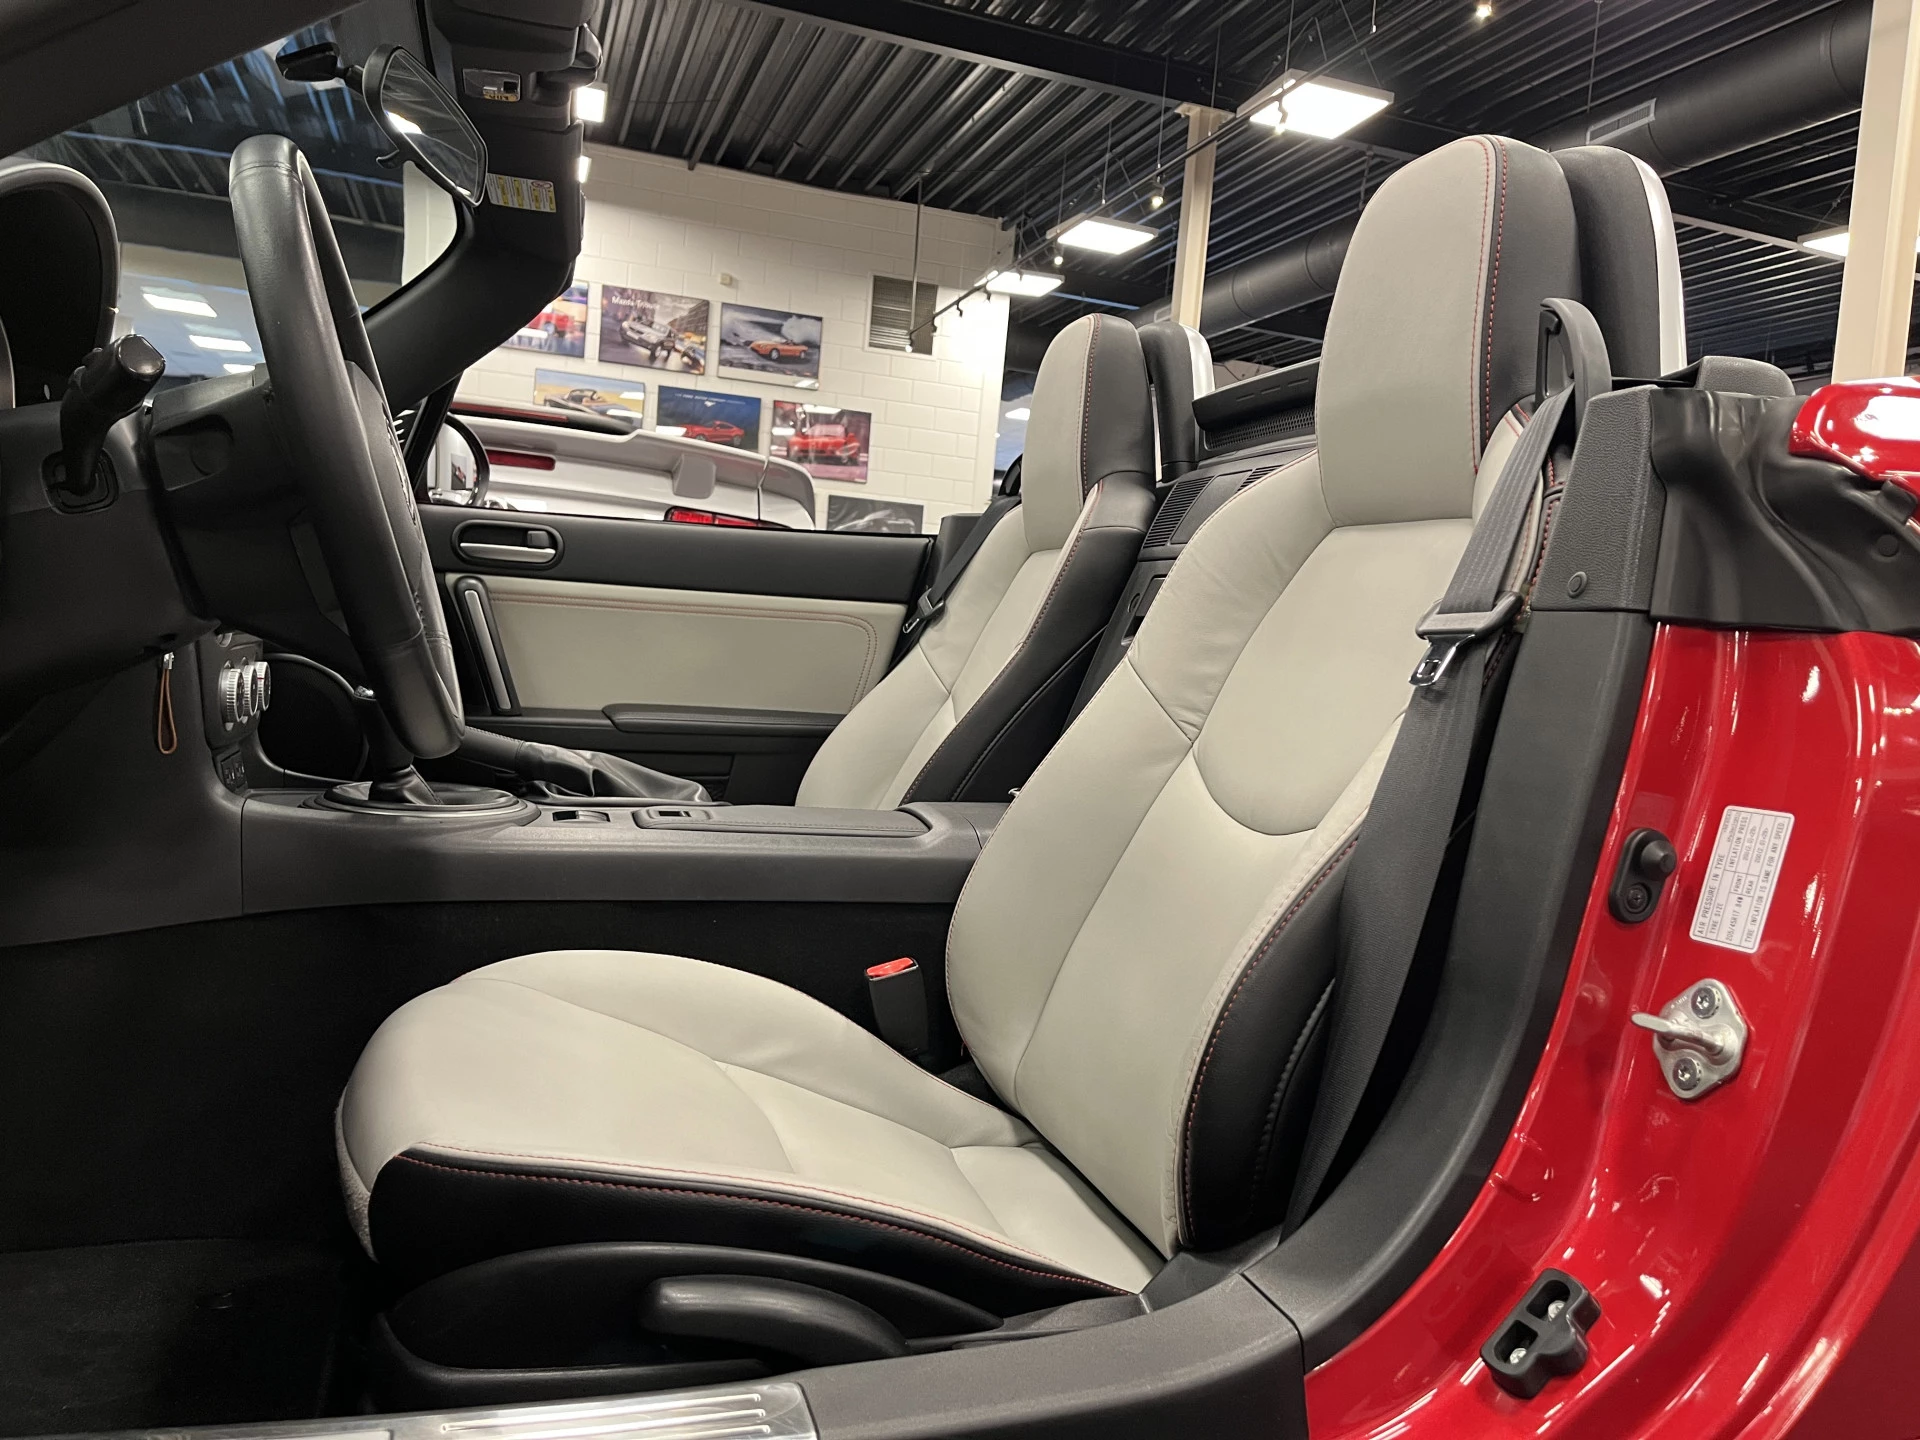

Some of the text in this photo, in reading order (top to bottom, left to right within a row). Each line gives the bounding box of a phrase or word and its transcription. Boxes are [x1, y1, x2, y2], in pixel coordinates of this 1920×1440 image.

[1728, 836, 1741, 867] INFLATION
[1737, 816, 1748, 834] PRESS
[1770, 842, 1779, 853] ANY
[1767, 855, 1775, 866] FOR
[1733, 875, 1742, 891] FRONT
[1762, 869, 1771, 882] SAME
[1697, 853, 1725, 934] AIR PRESSURE IN TYRE
[1745, 880, 1754, 894] REAR
[1750, 895, 1763, 925] INFLATION
[1709, 902, 1723, 934] TYRE SIZE
[1745, 929, 1753, 942] TYRE
